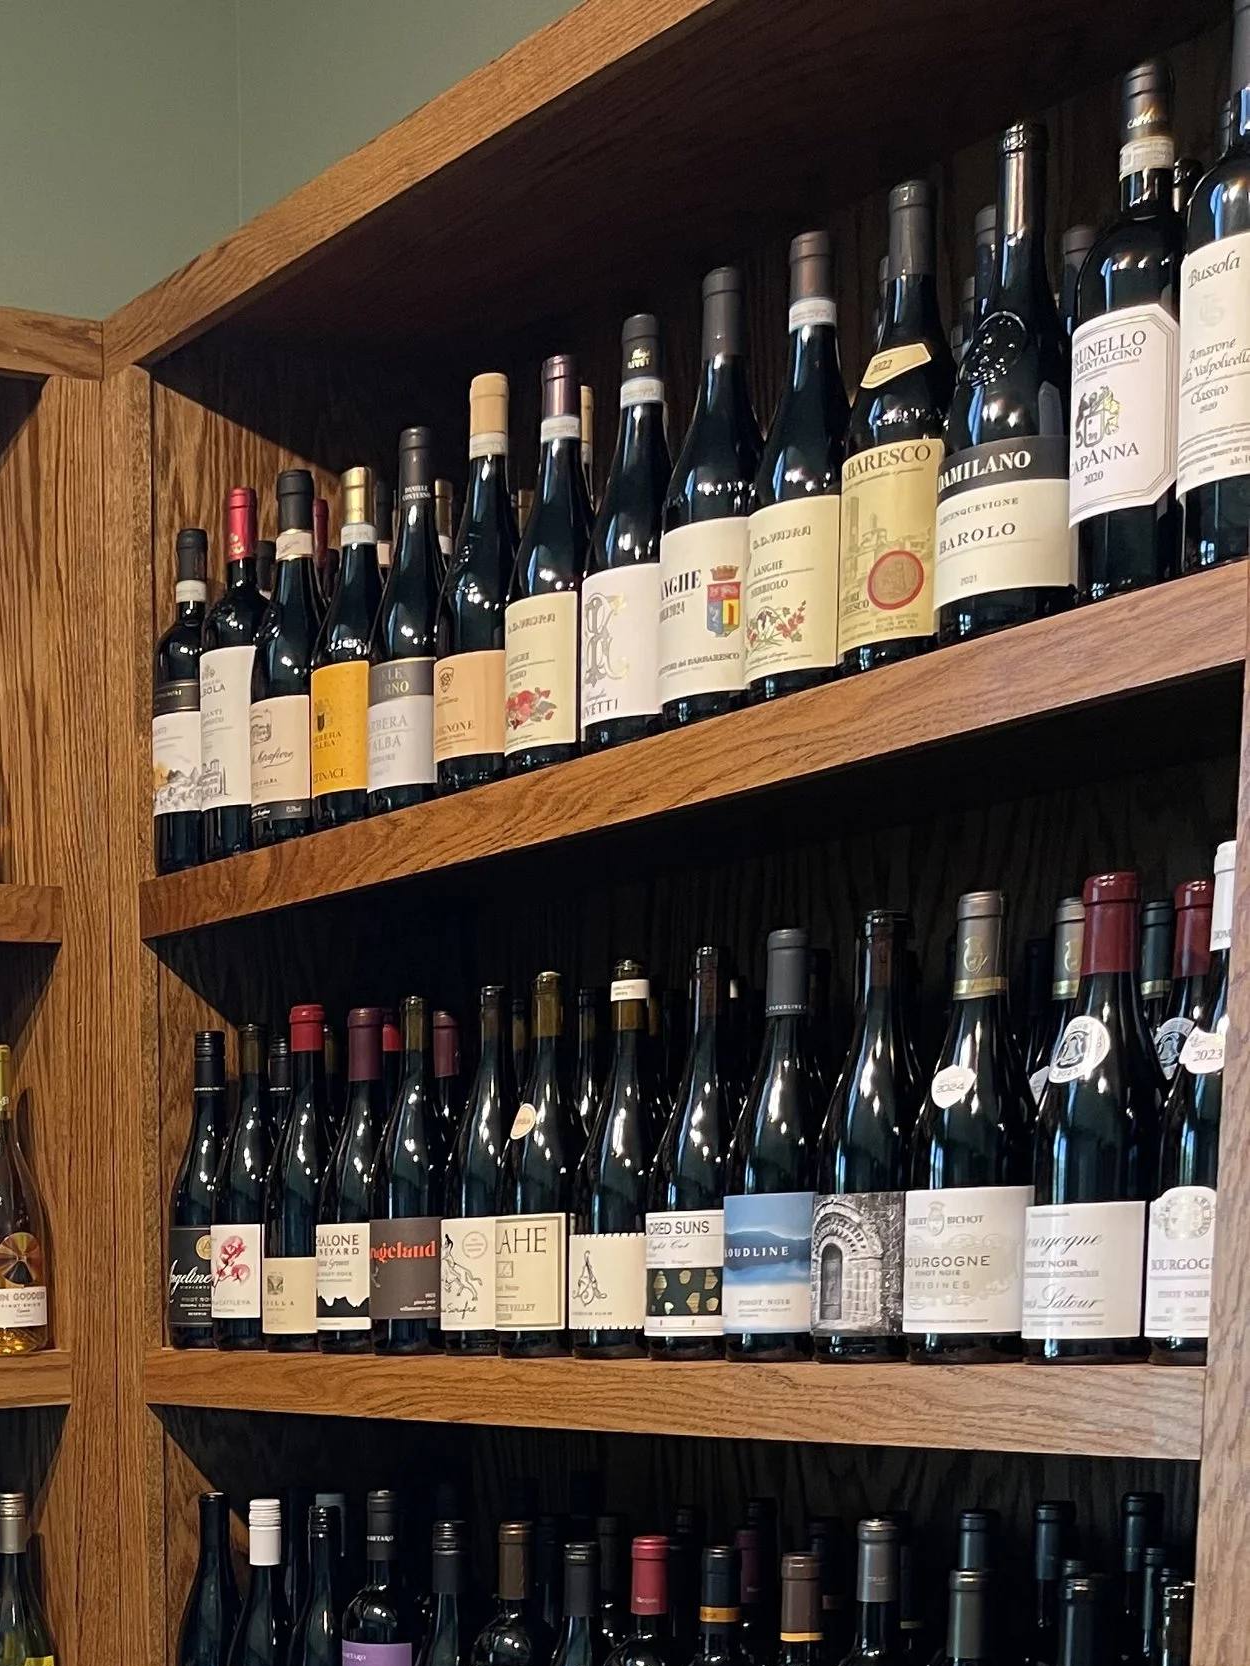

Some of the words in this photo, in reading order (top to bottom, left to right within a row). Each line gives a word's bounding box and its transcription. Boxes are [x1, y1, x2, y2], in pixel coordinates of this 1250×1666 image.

[1187, 250, 1242, 290] Bussola
[1188, 337, 1238, 365] Amarone
[937, 449, 1033, 494] DAMILANO
[1083, 470, 1104, 487] 2020
[938, 522, 1017, 556] BAROLO
[1193, 1049, 1224, 1062] 2023
[674, 1220, 710, 1234] SUNS
[947, 1214, 985, 1224] BICHOT
[1048, 1259, 1079, 1268] NOIR
[1037, 1282, 1105, 1309] Latour
